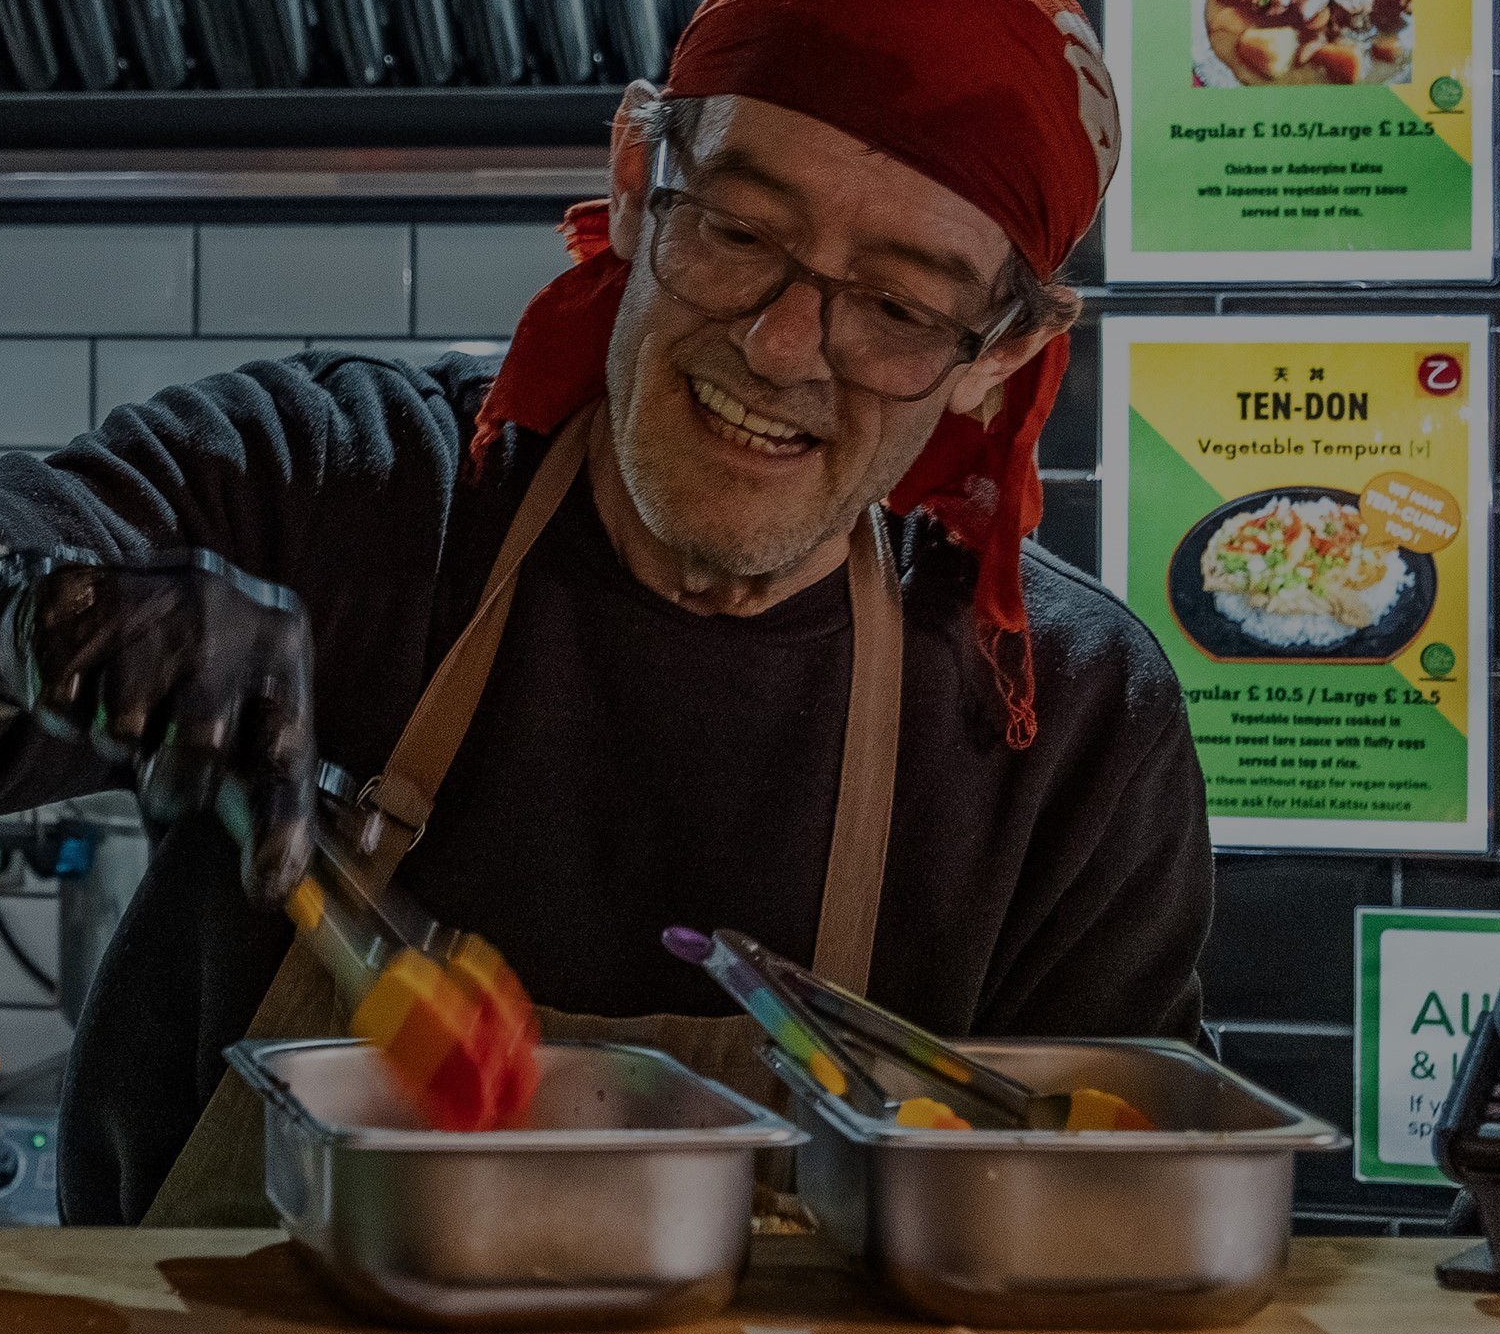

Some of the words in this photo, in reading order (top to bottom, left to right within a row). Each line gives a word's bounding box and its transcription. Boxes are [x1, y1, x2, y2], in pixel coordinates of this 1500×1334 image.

[1170, 123, 1246, 142] Regular
[1252, 122, 1265, 138] £
[1379, 121, 1391, 136] £
[1397, 121, 1434, 137] 12.5
[1225, 164, 1267, 175] Chicken
[1272, 165, 1283, 174] or
[1287, 163, 1346, 176] Aubergine
[1351, 163, 1382, 174] Katsu
[1198, 186, 1221, 197] with
[1226, 186, 1278, 198] Japanese
[1283, 185, 1339, 198] vegetable
[1343, 186, 1371, 198] curry
[1375, 186, 1408, 195] sauce
[1242, 206, 1279, 217] served
[1284, 208, 1297, 217] on
[1301, 206, 1319, 219] top
[1324, 206, 1335, 216] of
[1274, 367, 1324, 382] 天丼
[1236, 392, 1369, 421] TEN-DON
[1198, 438, 1304, 459] Vegetable
[1312, 439, 1402, 459] Tempura
[1366, 490, 1456, 539] TEN-CURRY
[1247, 685, 1259, 702] £
[1266, 688, 1302, 703] 10.5
[1321, 688, 1376, 707] Large
[1384, 688, 1396, 704] £
[1402, 690, 1440, 706] 12.5
[1231, 713, 1289, 726] Vegetable
[1292, 714, 1341, 727] tempura
[1345, 715, 1386, 726] cooked
[1390, 716, 1400, 726] in
[1236, 736, 1270, 746] sweet
[1273, 736, 1296, 746] tare
[1300, 738, 1332, 747] sauce
[1336, 737, 1360, 748] with
[1364, 738, 1394, 750] fluffy
[1398, 740, 1425, 750] eggs
[1238, 756, 1277, 768] served
[1281, 758, 1295, 767] on
[1298, 758, 1317, 770] top
[1322, 757, 1332, 768] of
[1250, 777, 1296, 786] without
[1300, 779, 1326, 790] eggs
[1329, 778, 1346, 788] for
[1350, 780, 1385, 791] vegan
[1388, 779, 1431, 791] option.
[1242, 796, 1263, 808] ask
[1268, 797, 1287, 808] for
[1290, 798, 1325, 809] Halal
[1330, 798, 1368, 810] Katsu
[1372, 800, 1410, 810] sauce
[1410, 1051, 1436, 1080] &
[1410, 1096, 1423, 1112] If
